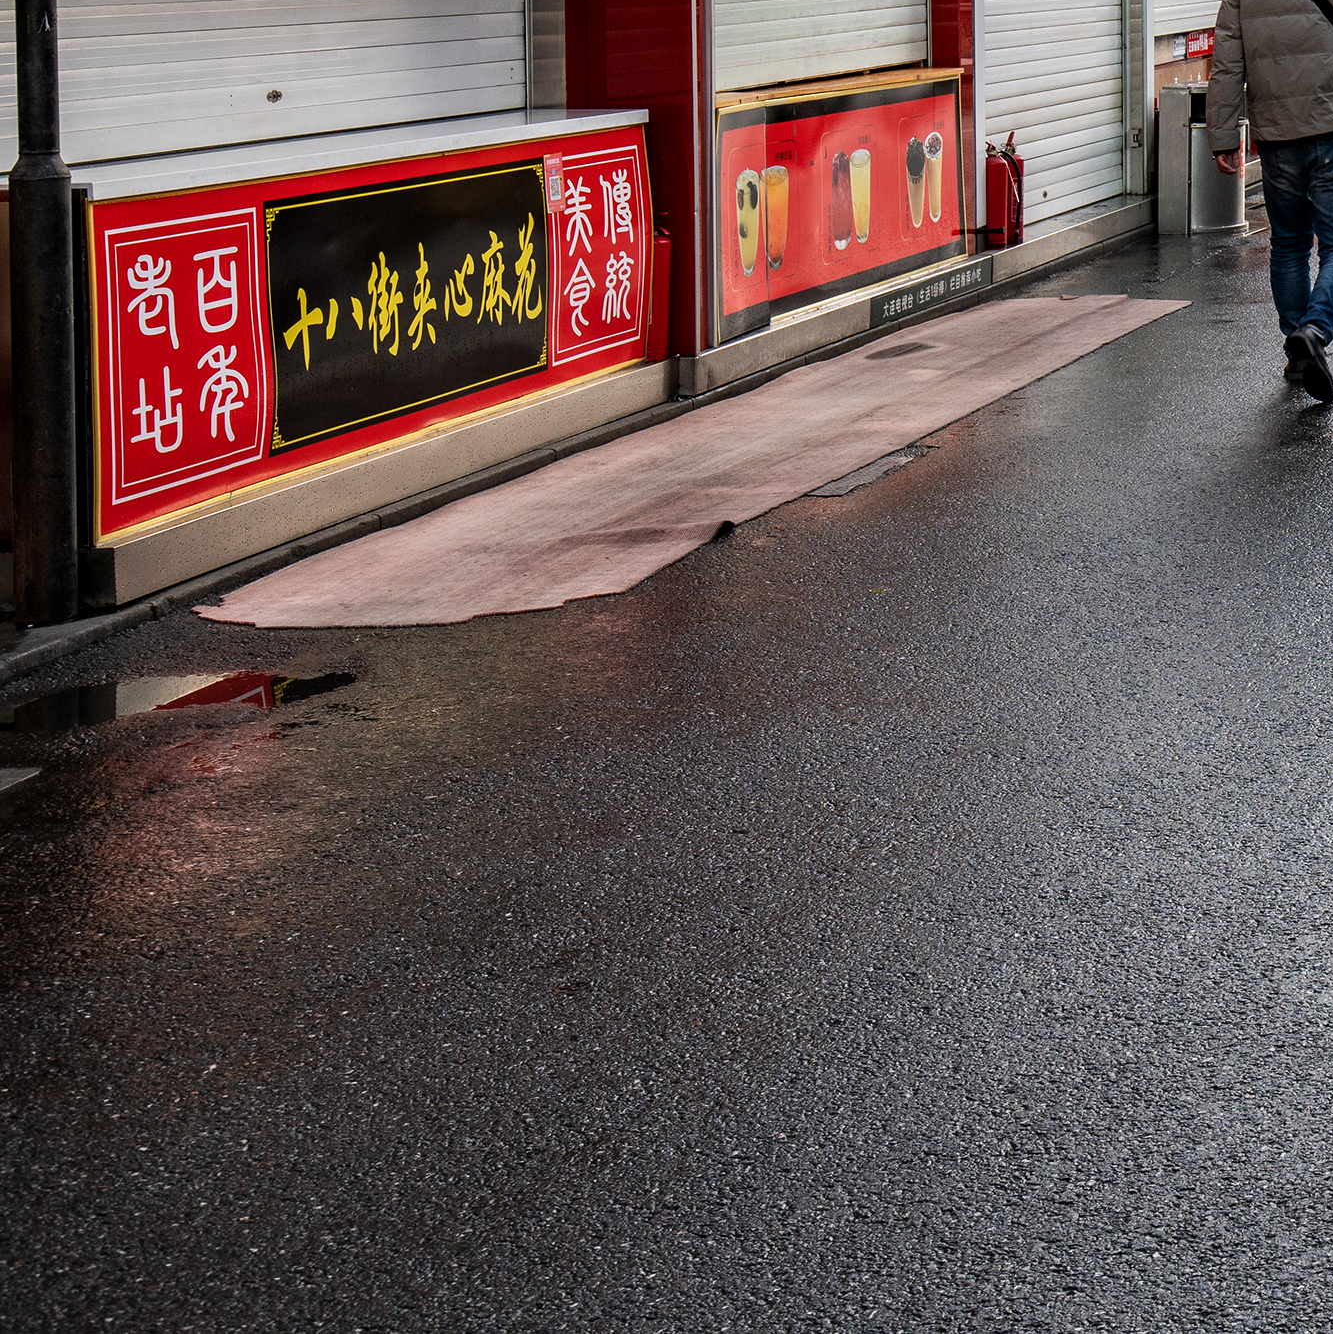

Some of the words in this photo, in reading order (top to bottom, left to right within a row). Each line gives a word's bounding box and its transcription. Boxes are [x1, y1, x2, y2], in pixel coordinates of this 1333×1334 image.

[284, 214, 543, 370] 十八街夹心麻花
